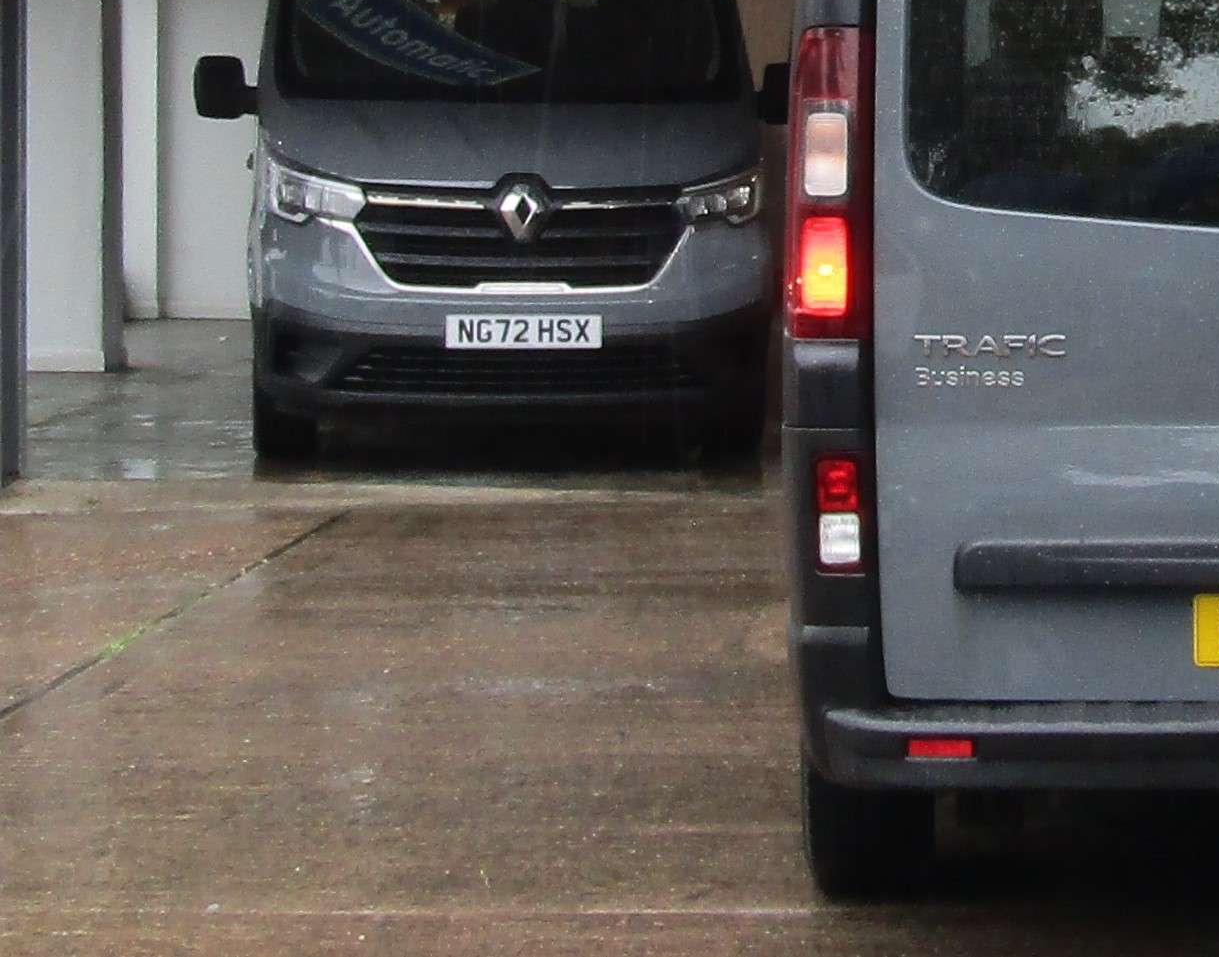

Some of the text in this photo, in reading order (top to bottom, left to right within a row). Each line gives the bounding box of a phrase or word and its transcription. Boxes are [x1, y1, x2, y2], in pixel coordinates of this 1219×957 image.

[457, 319, 591, 343] NG72 HSX
[914, 333, 1066, 357] TRAFIC
[915, 365, 1025, 386] Business
